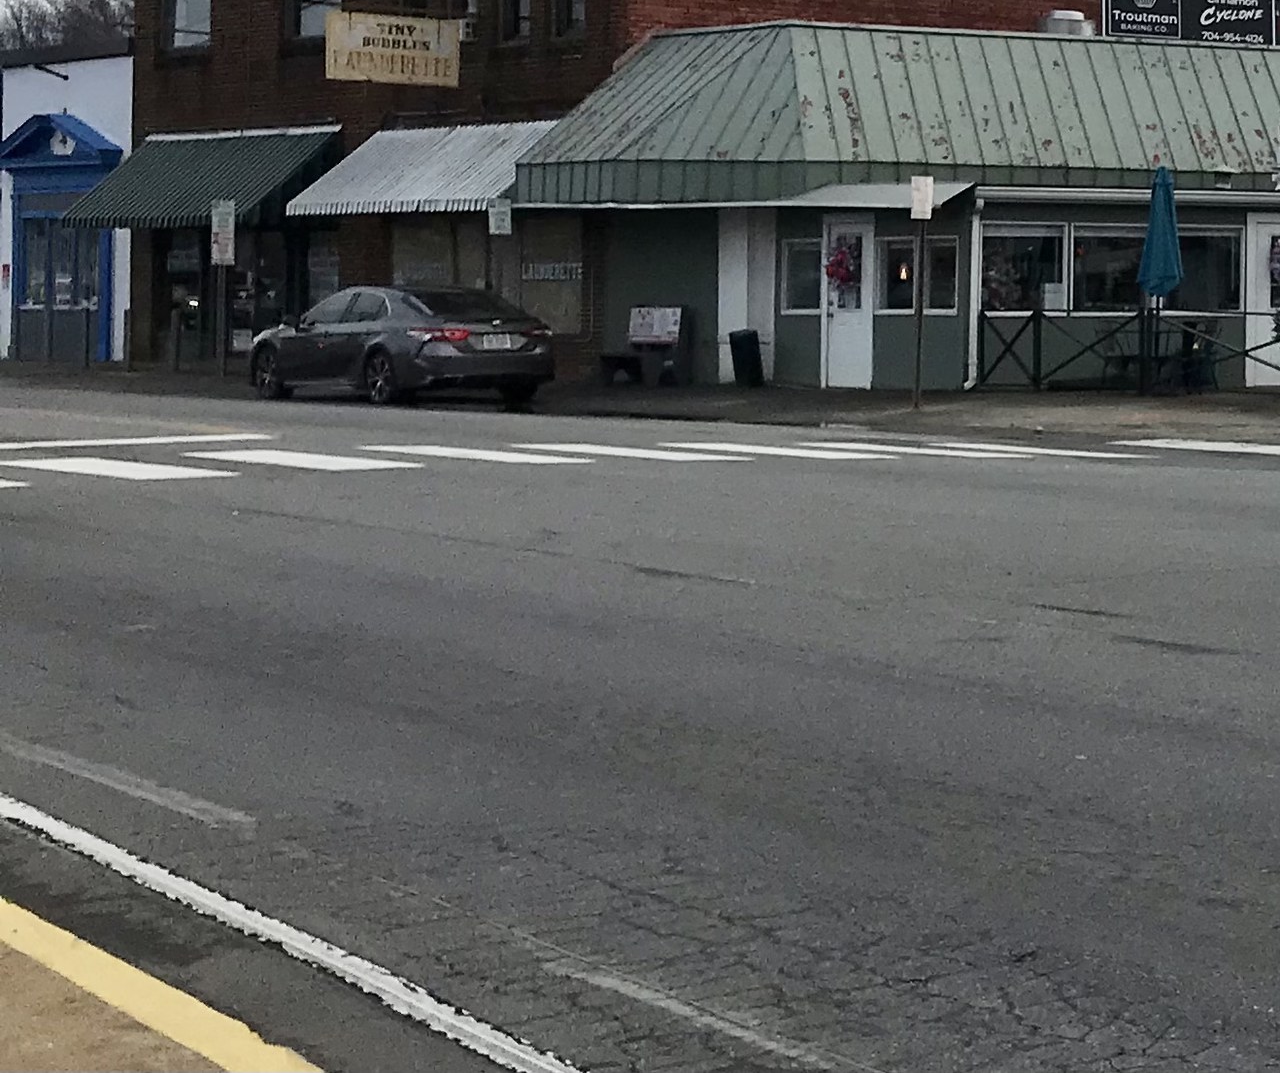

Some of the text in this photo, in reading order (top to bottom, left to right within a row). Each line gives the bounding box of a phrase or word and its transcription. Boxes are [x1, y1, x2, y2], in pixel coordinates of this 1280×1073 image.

[1112, 10, 1178, 24] Troutman
[376, 23, 417, 36] TINY
[1120, 23, 1153, 32] BAKING
[362, 36, 431, 51] BUBBLES
